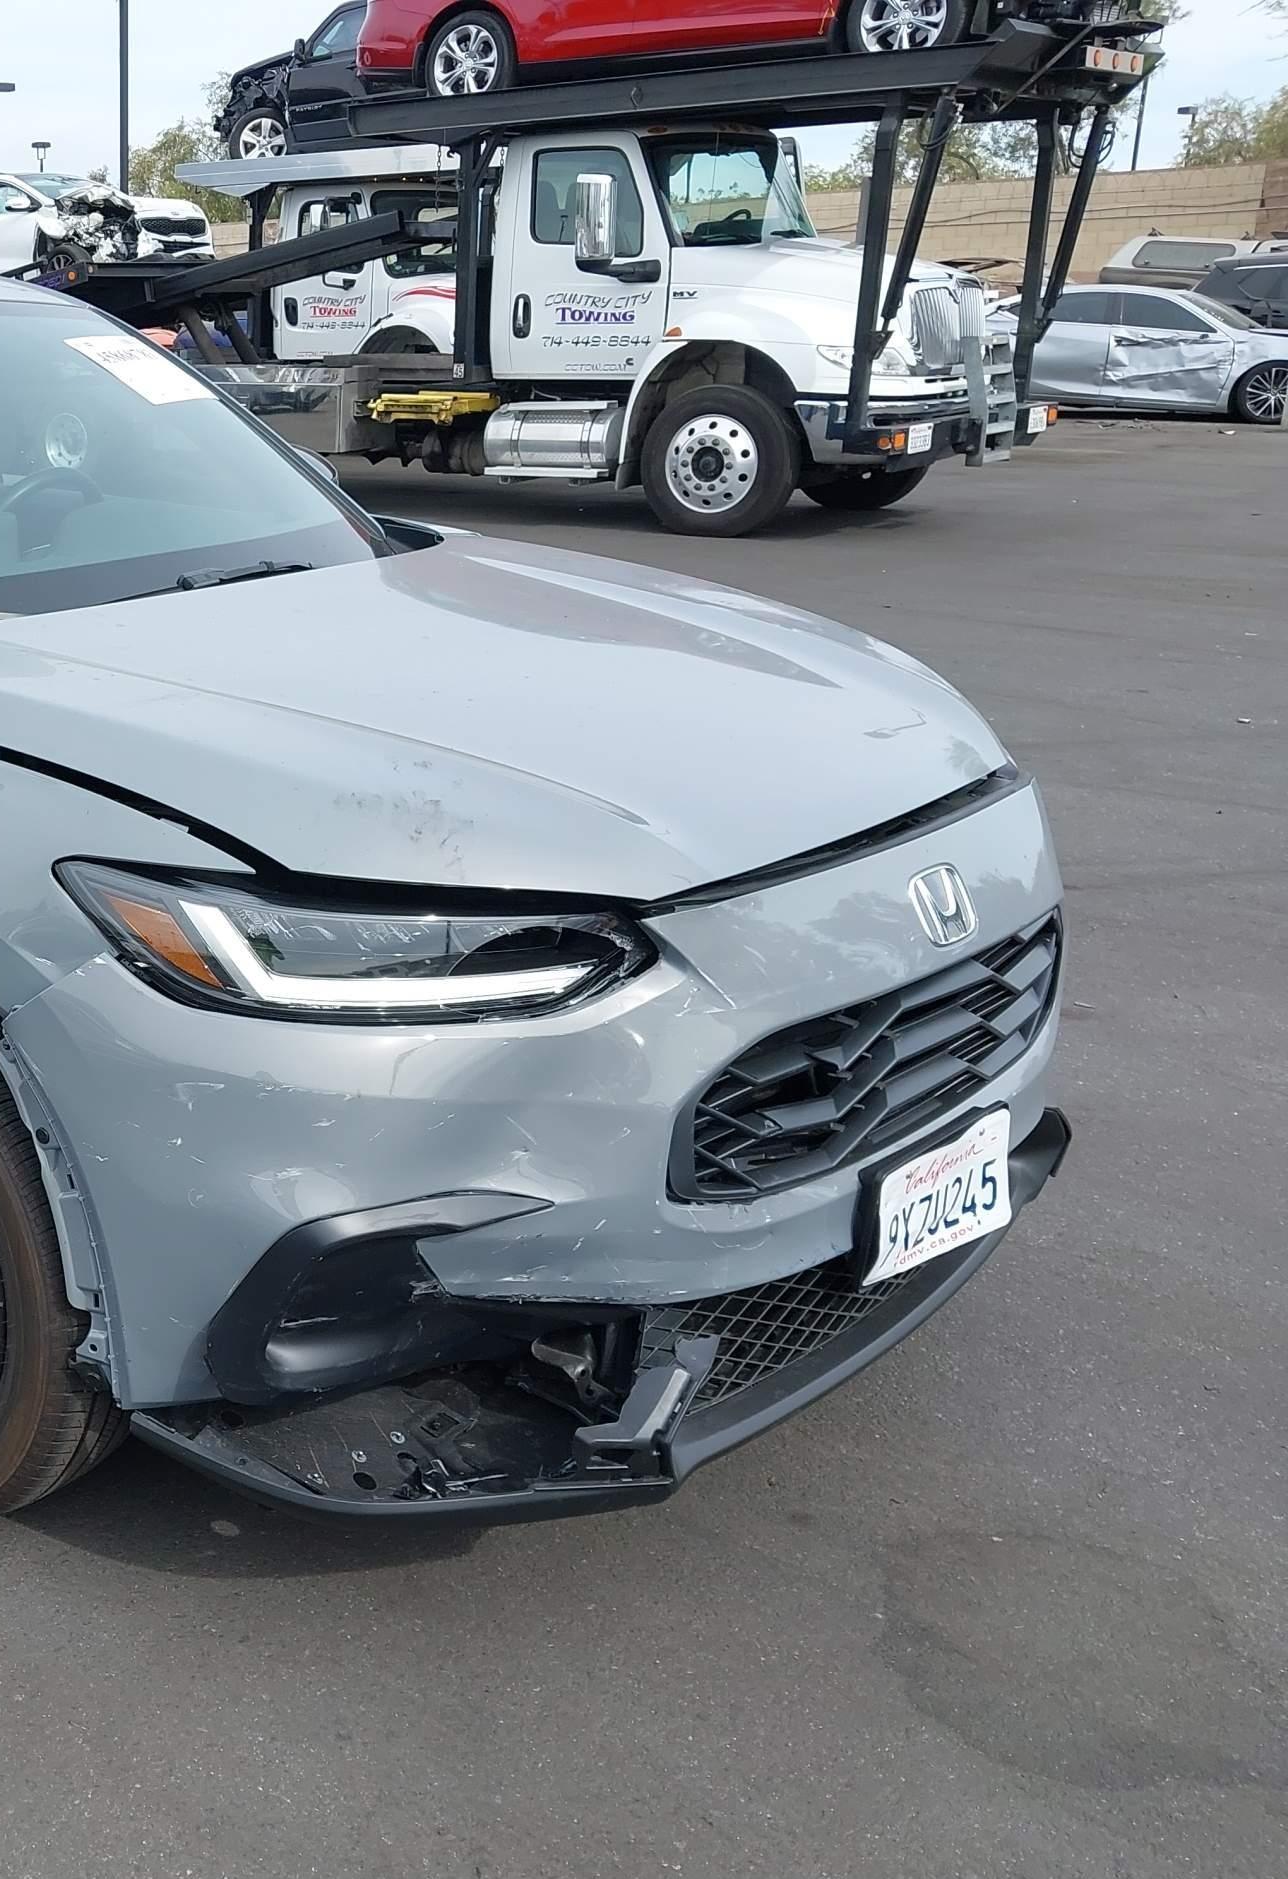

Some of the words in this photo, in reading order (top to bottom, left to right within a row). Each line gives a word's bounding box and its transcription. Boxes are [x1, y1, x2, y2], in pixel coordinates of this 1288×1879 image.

[302, 296, 342, 307] COUNTRY
[344, 294, 367, 307] CITY
[545, 292, 612, 309] COUNTRY
[614, 290, 653, 309] CITY
[541, 335, 652, 348] 714-449-8844
[904, 1143, 984, 1195] California
[899, 1223, 974, 1266] dmv.ca.gov
